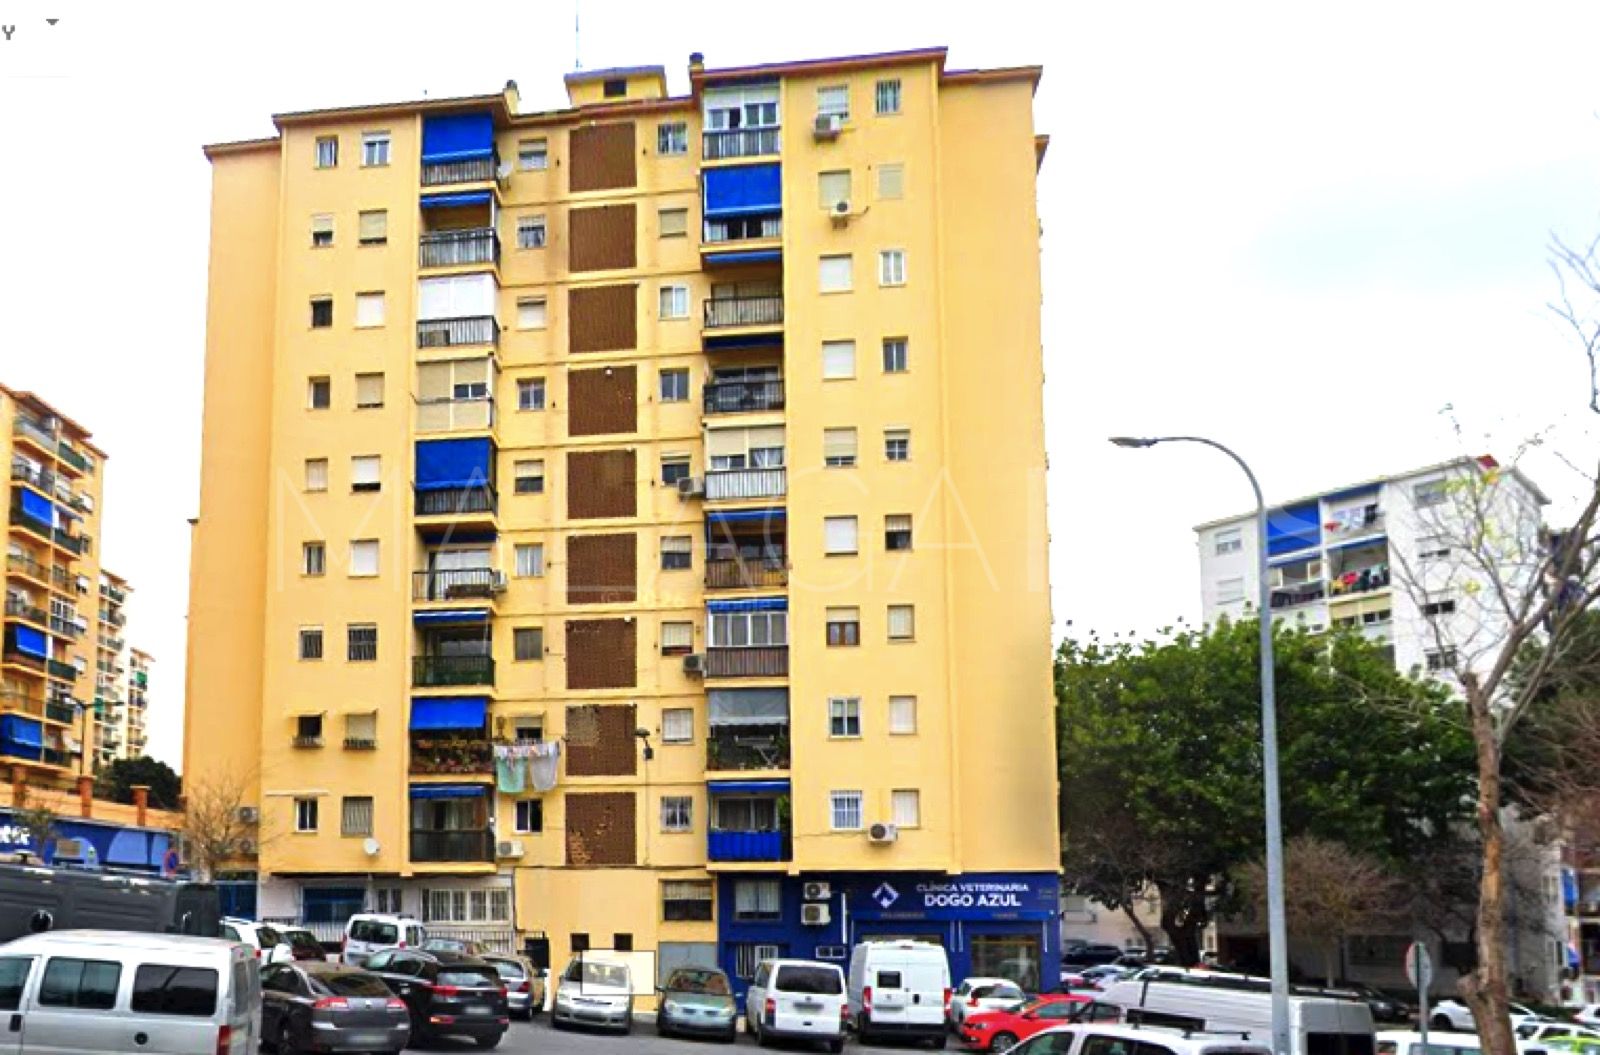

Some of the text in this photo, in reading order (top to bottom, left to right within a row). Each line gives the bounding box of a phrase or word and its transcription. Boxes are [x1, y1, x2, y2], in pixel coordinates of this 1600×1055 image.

[959, 883, 1030, 892] VETERINARIA
[924, 893, 1022, 907] DOGO AZUL
